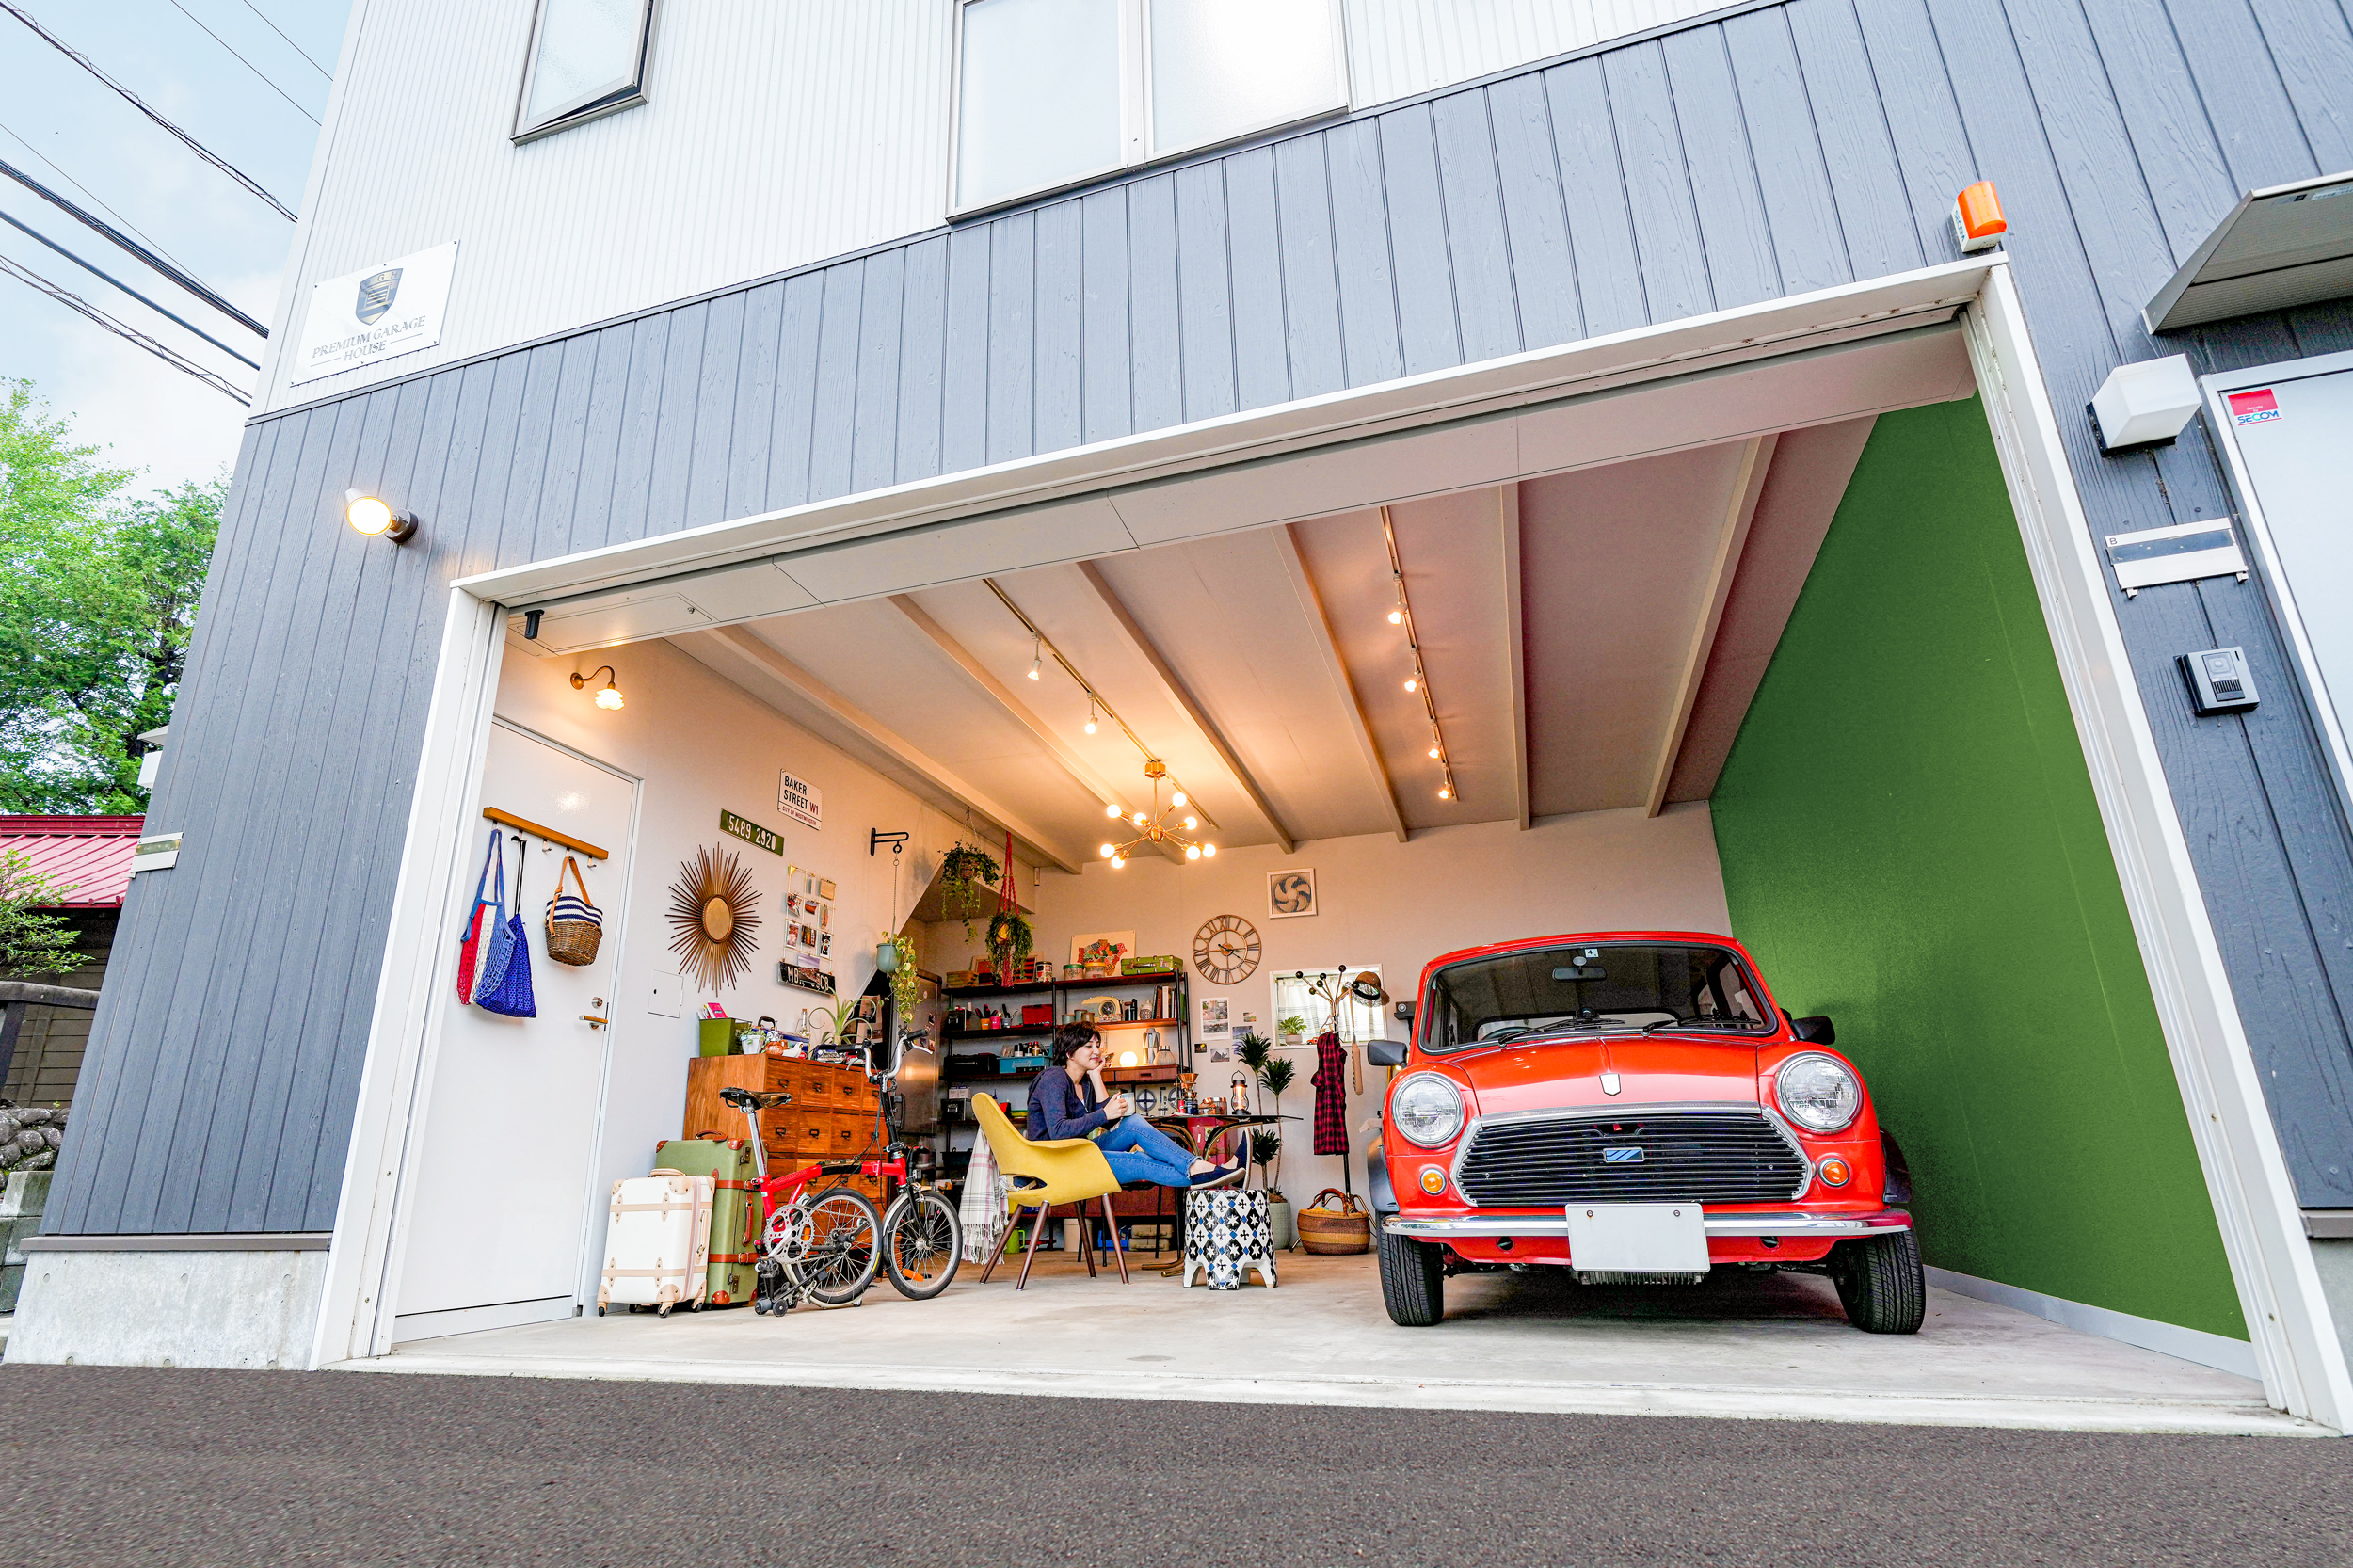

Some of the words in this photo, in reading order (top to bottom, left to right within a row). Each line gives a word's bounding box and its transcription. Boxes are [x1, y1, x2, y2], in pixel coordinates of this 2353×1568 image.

[312, 332, 372, 359] PREMIUM
[373, 315, 426, 340] GARAGE
[344, 340, 387, 362] HOUSE
[2237, 410, 2280, 424] SECOM
[784, 775, 808, 796] BAKER
[782, 806, 791, 814] CITY
[783, 789, 808, 810] STREET
[809, 801, 819, 816] W1
[728, 814, 752, 840] 5489
[788, 966, 802, 984] MB
